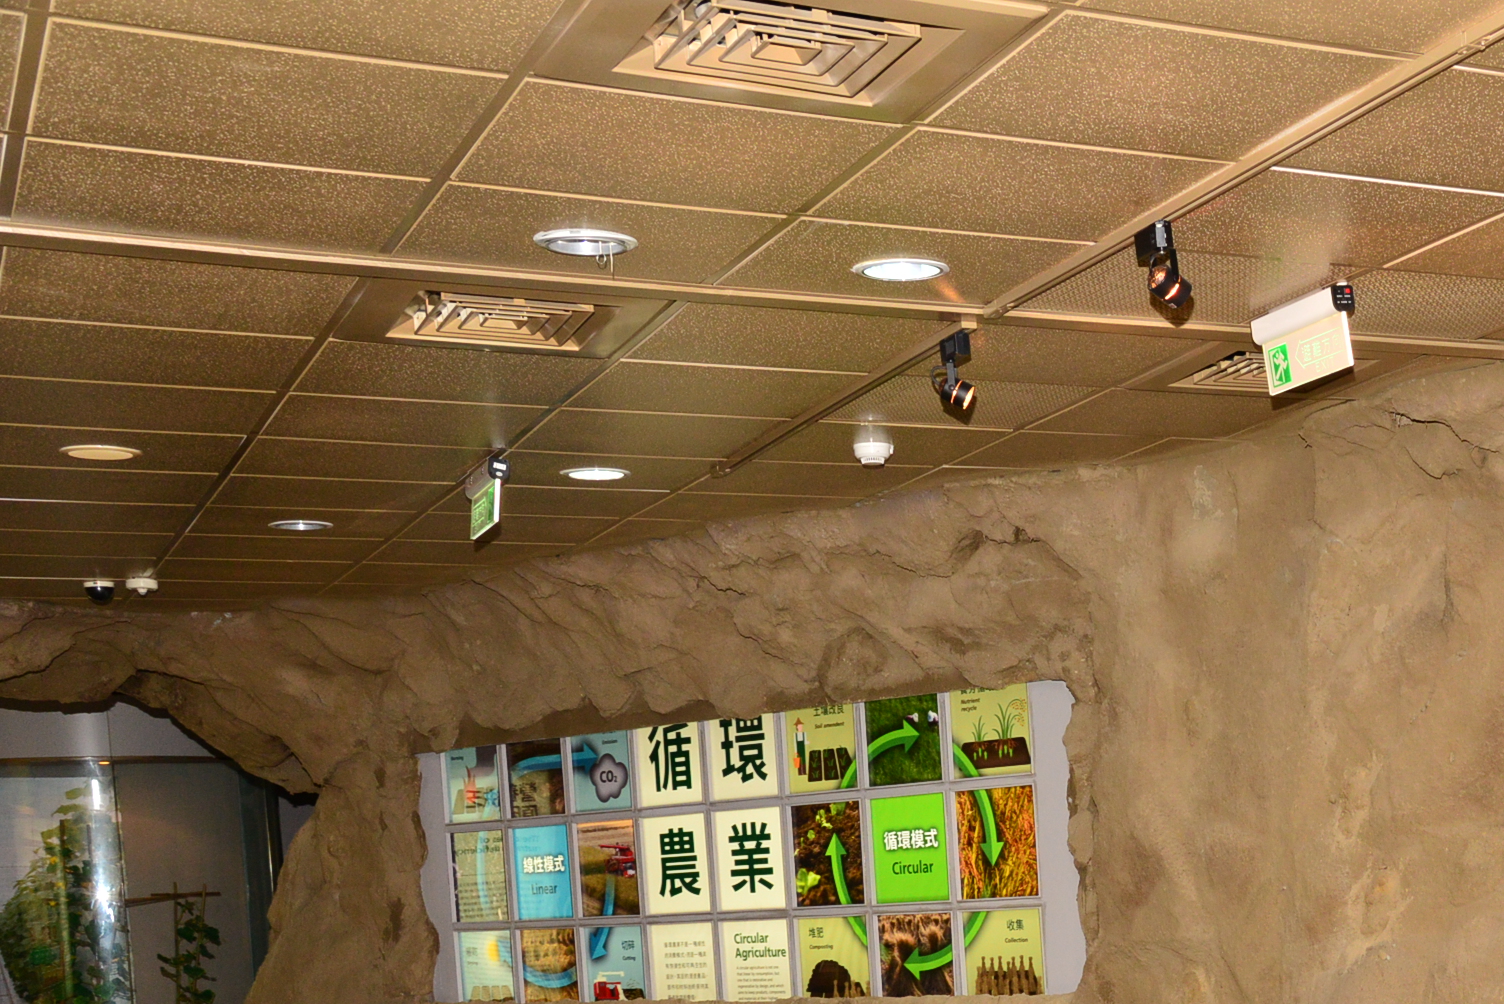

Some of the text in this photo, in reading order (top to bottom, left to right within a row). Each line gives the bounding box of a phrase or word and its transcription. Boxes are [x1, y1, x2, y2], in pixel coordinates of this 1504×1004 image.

[884, 828, 939, 852] 循環模式
[523, 854, 566, 875] 線性模式
[890, 860, 934, 878] Circular
[531, 883, 558, 895] Linear
[733, 932, 769, 945] Circular
[735, 946, 787, 961] Agriculture
